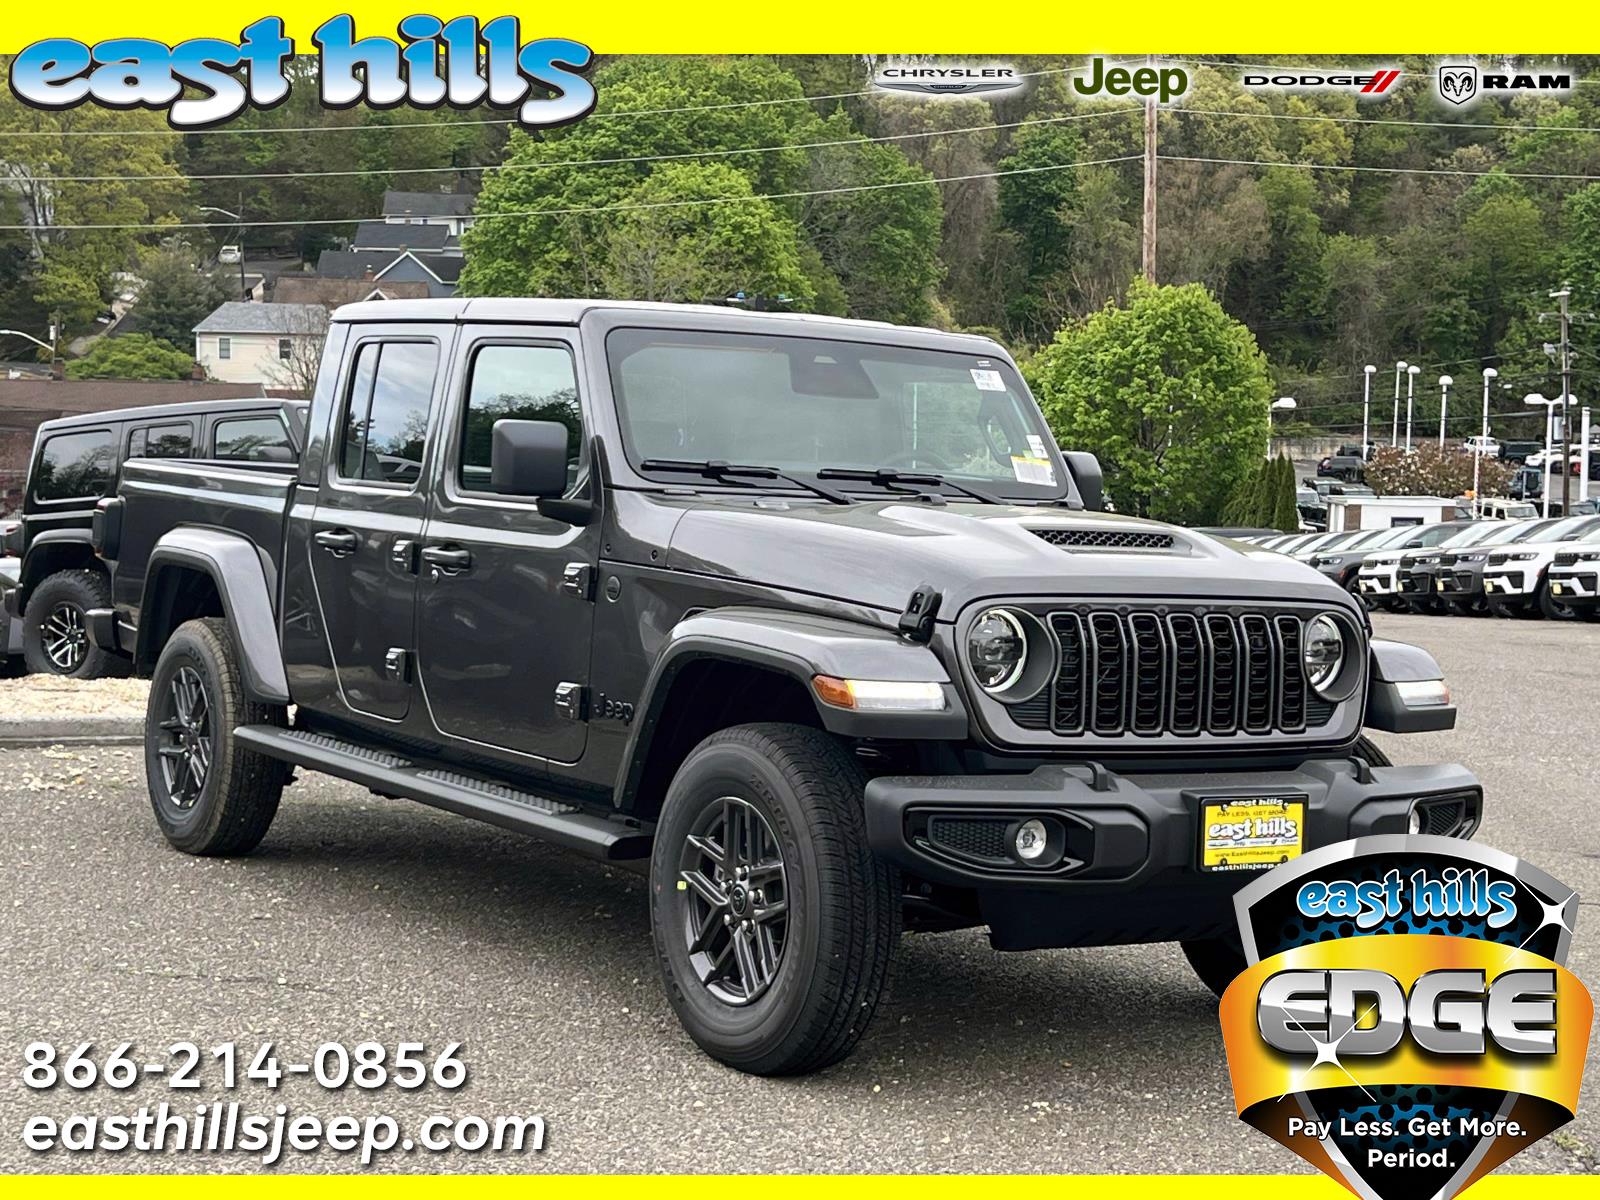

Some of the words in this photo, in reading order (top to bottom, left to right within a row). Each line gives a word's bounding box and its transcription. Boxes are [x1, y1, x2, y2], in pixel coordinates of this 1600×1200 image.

[592, 692, 635, 727] Jeep
[1208, 818, 1252, 840] east
[1254, 816, 1298, 839] hills
